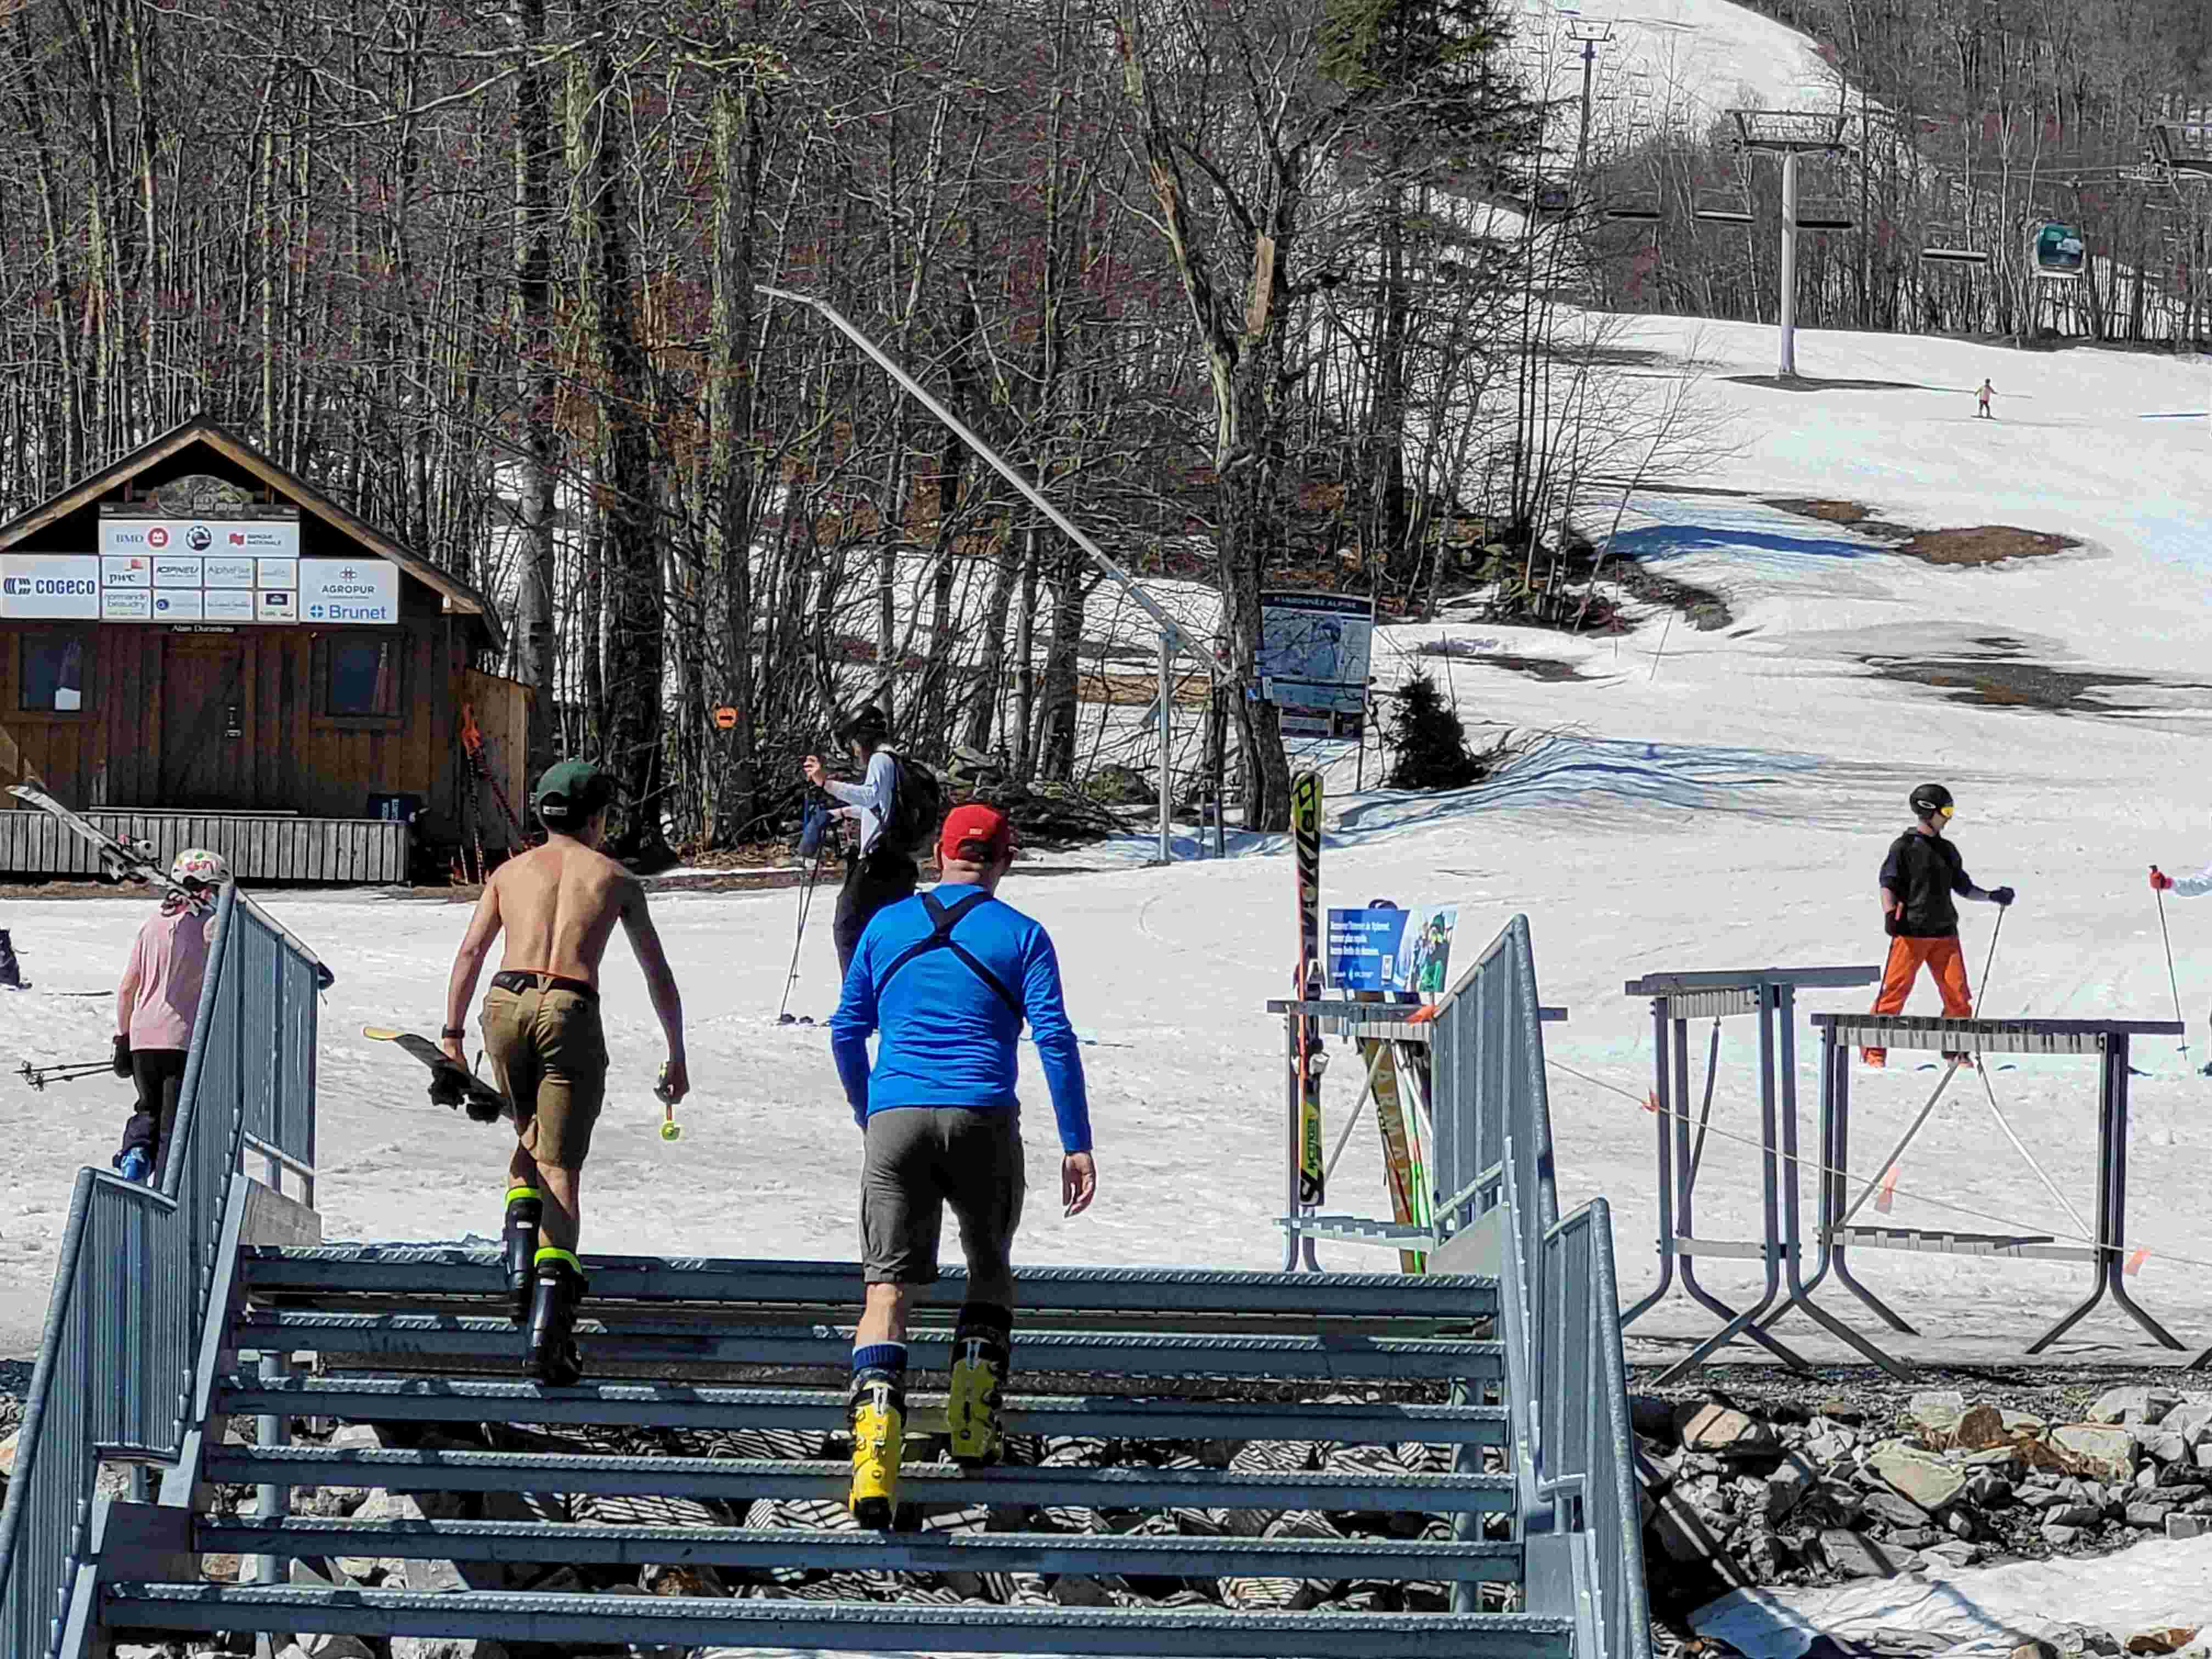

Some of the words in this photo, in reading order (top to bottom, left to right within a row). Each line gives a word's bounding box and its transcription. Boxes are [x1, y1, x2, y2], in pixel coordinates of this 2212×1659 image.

[116, 534, 144, 543] BMO
[109, 574, 136, 584] pwc
[321, 585, 375, 594] AGROPUR
[329, 605, 386, 619] Brunet
